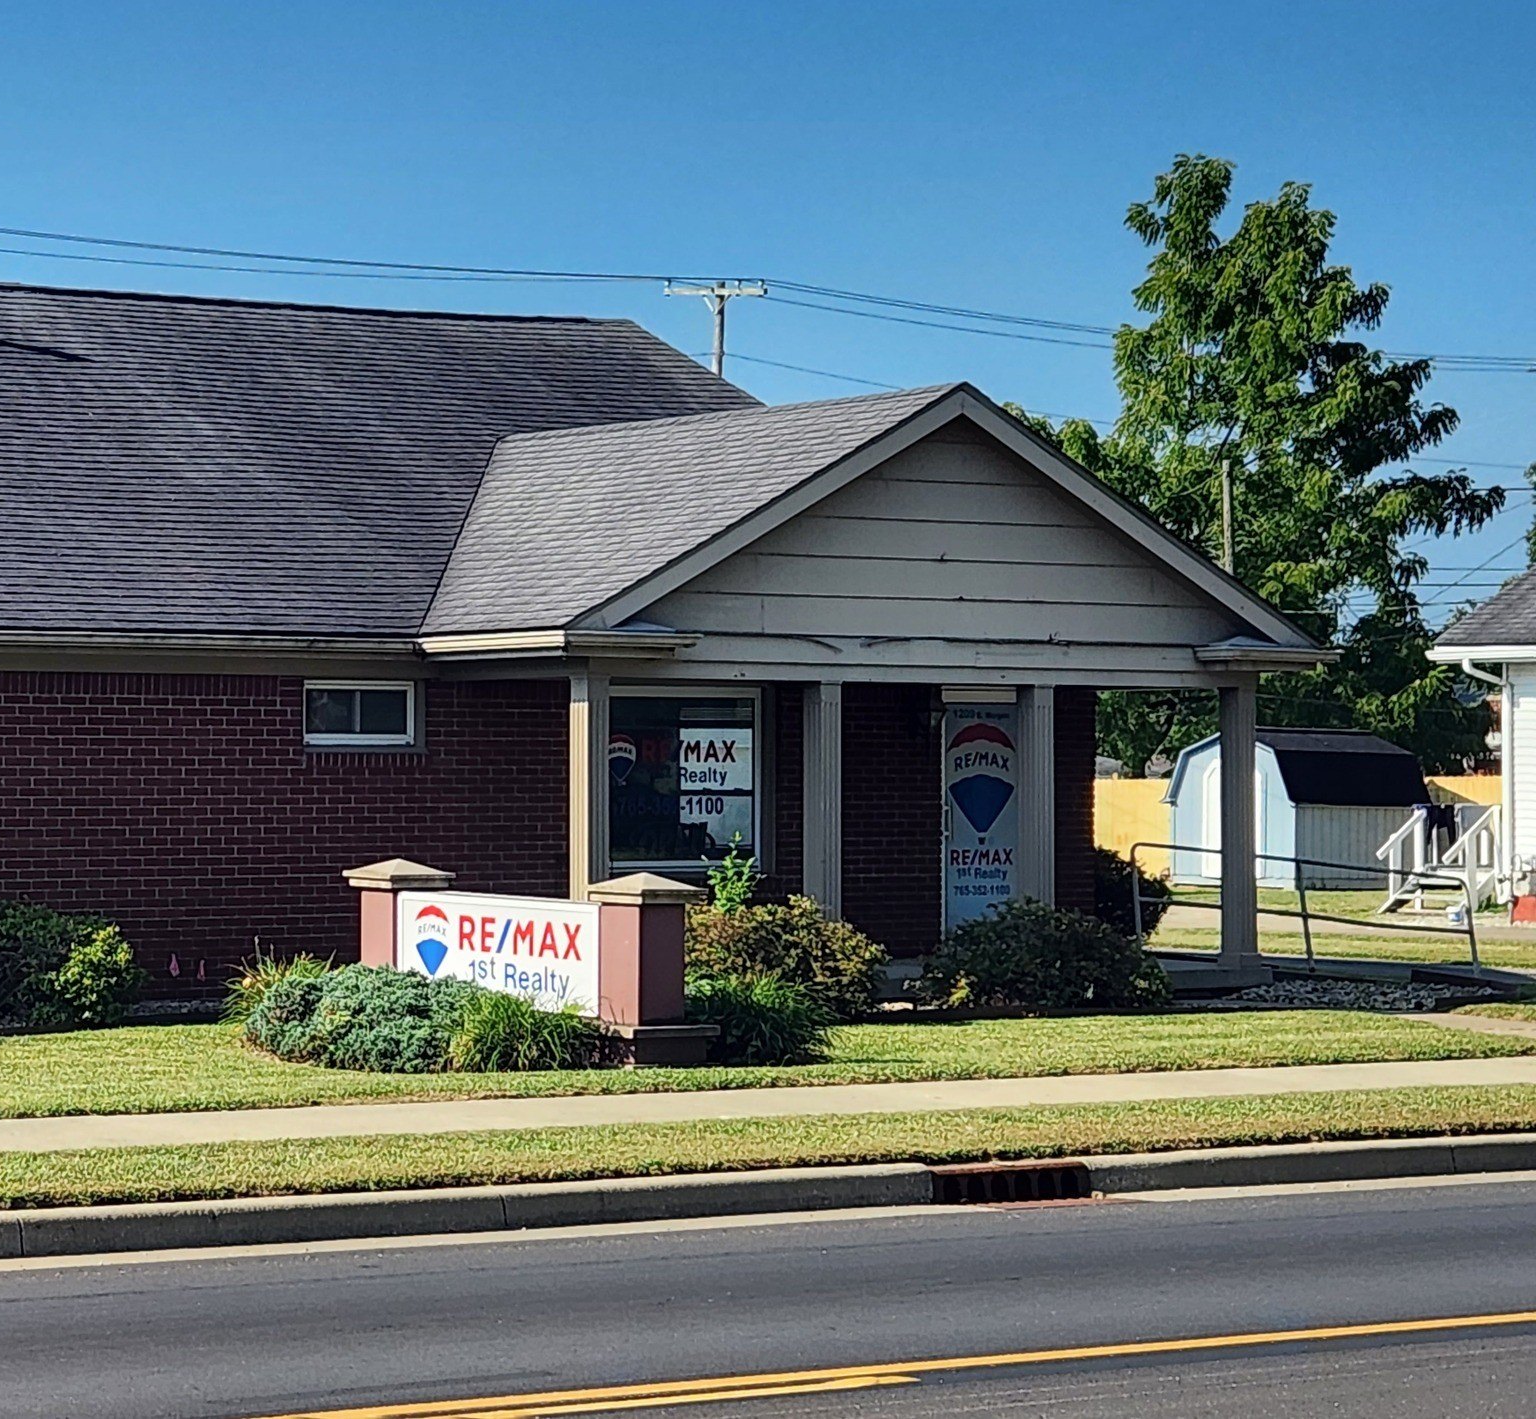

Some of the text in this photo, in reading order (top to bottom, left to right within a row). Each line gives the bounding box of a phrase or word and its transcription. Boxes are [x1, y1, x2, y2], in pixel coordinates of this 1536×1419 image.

[954, 751, 1009, 772] RE/MAX
[679, 767, 728, 786] Realty
[950, 848, 1013, 866] RE/MAX
[956, 866, 1008, 881] 1st Realty
[418, 923, 447, 937] RE/MAX
[458, 915, 582, 961] RE/MAX
[468, 956, 570, 999] 1st Realty
